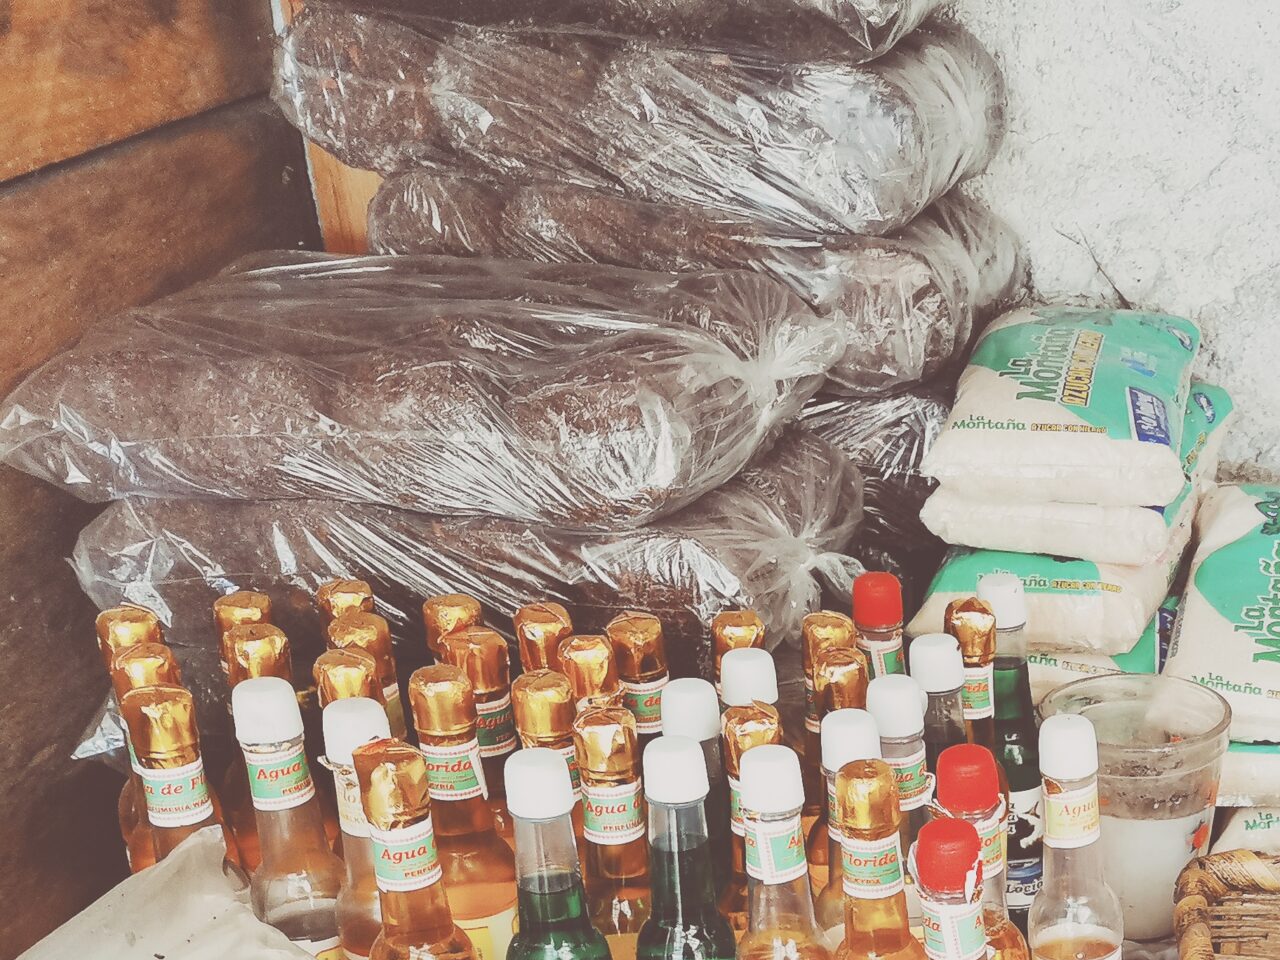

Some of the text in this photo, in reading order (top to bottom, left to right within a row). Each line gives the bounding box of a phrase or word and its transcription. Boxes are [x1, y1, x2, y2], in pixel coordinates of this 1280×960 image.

[951, 418, 1027, 431] Montaña
[969, 414, 985, 422] La
[1234, 605, 1265, 632] La
[1208, 672, 1223, 682] La
[257, 761, 302, 782] Agua
[161, 783, 183, 796] de
[586, 802, 628, 816] Agua
[381, 844, 428, 865] Agua
